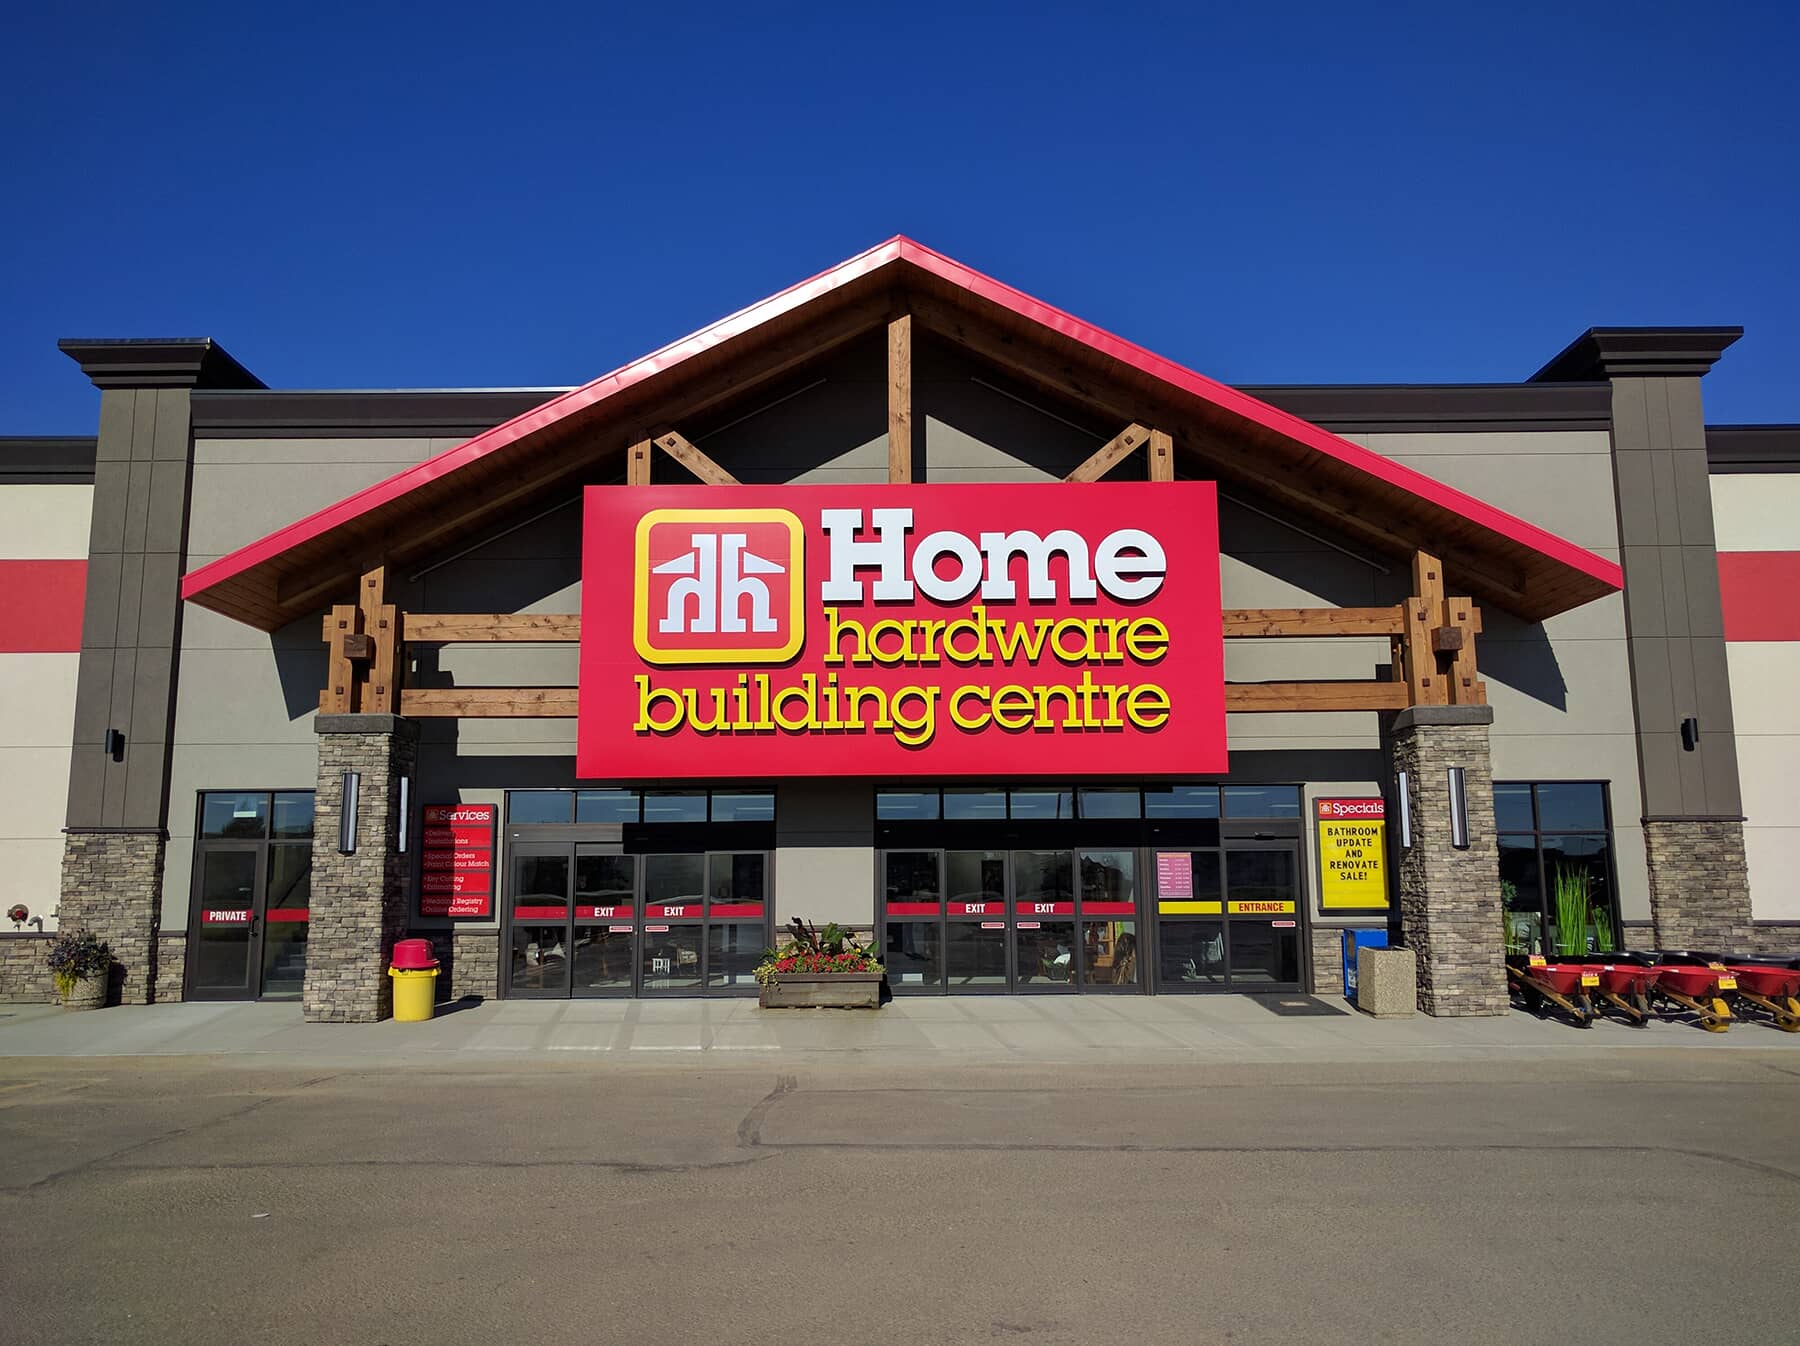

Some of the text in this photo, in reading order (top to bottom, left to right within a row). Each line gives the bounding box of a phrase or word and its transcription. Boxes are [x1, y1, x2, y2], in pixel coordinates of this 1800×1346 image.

[820, 508, 1167, 600] Home
[824, 605, 1169, 663] hardware
[633, 670, 1170, 745] building centre
[1333, 802, 1384, 816] Specials
[439, 809, 490, 821] Services
[1327, 827, 1378, 836] BATHROOM
[1336, 838, 1372, 847] UPDATE
[1345, 849, 1363, 858] AND
[1329, 860, 1378, 869] RENOVATE
[1340, 871, 1367, 880] SALE!
[448, 906, 479, 914] Ordering
[594, 907, 615, 917] EXIT
[664, 906, 684, 916] EXIT
[965, 903, 986, 913] EXIT
[1034, 903, 1055, 913] EXIT
[1238, 902, 1284, 912] ENTRANCE
[209, 911, 247, 921] PRIVATE
